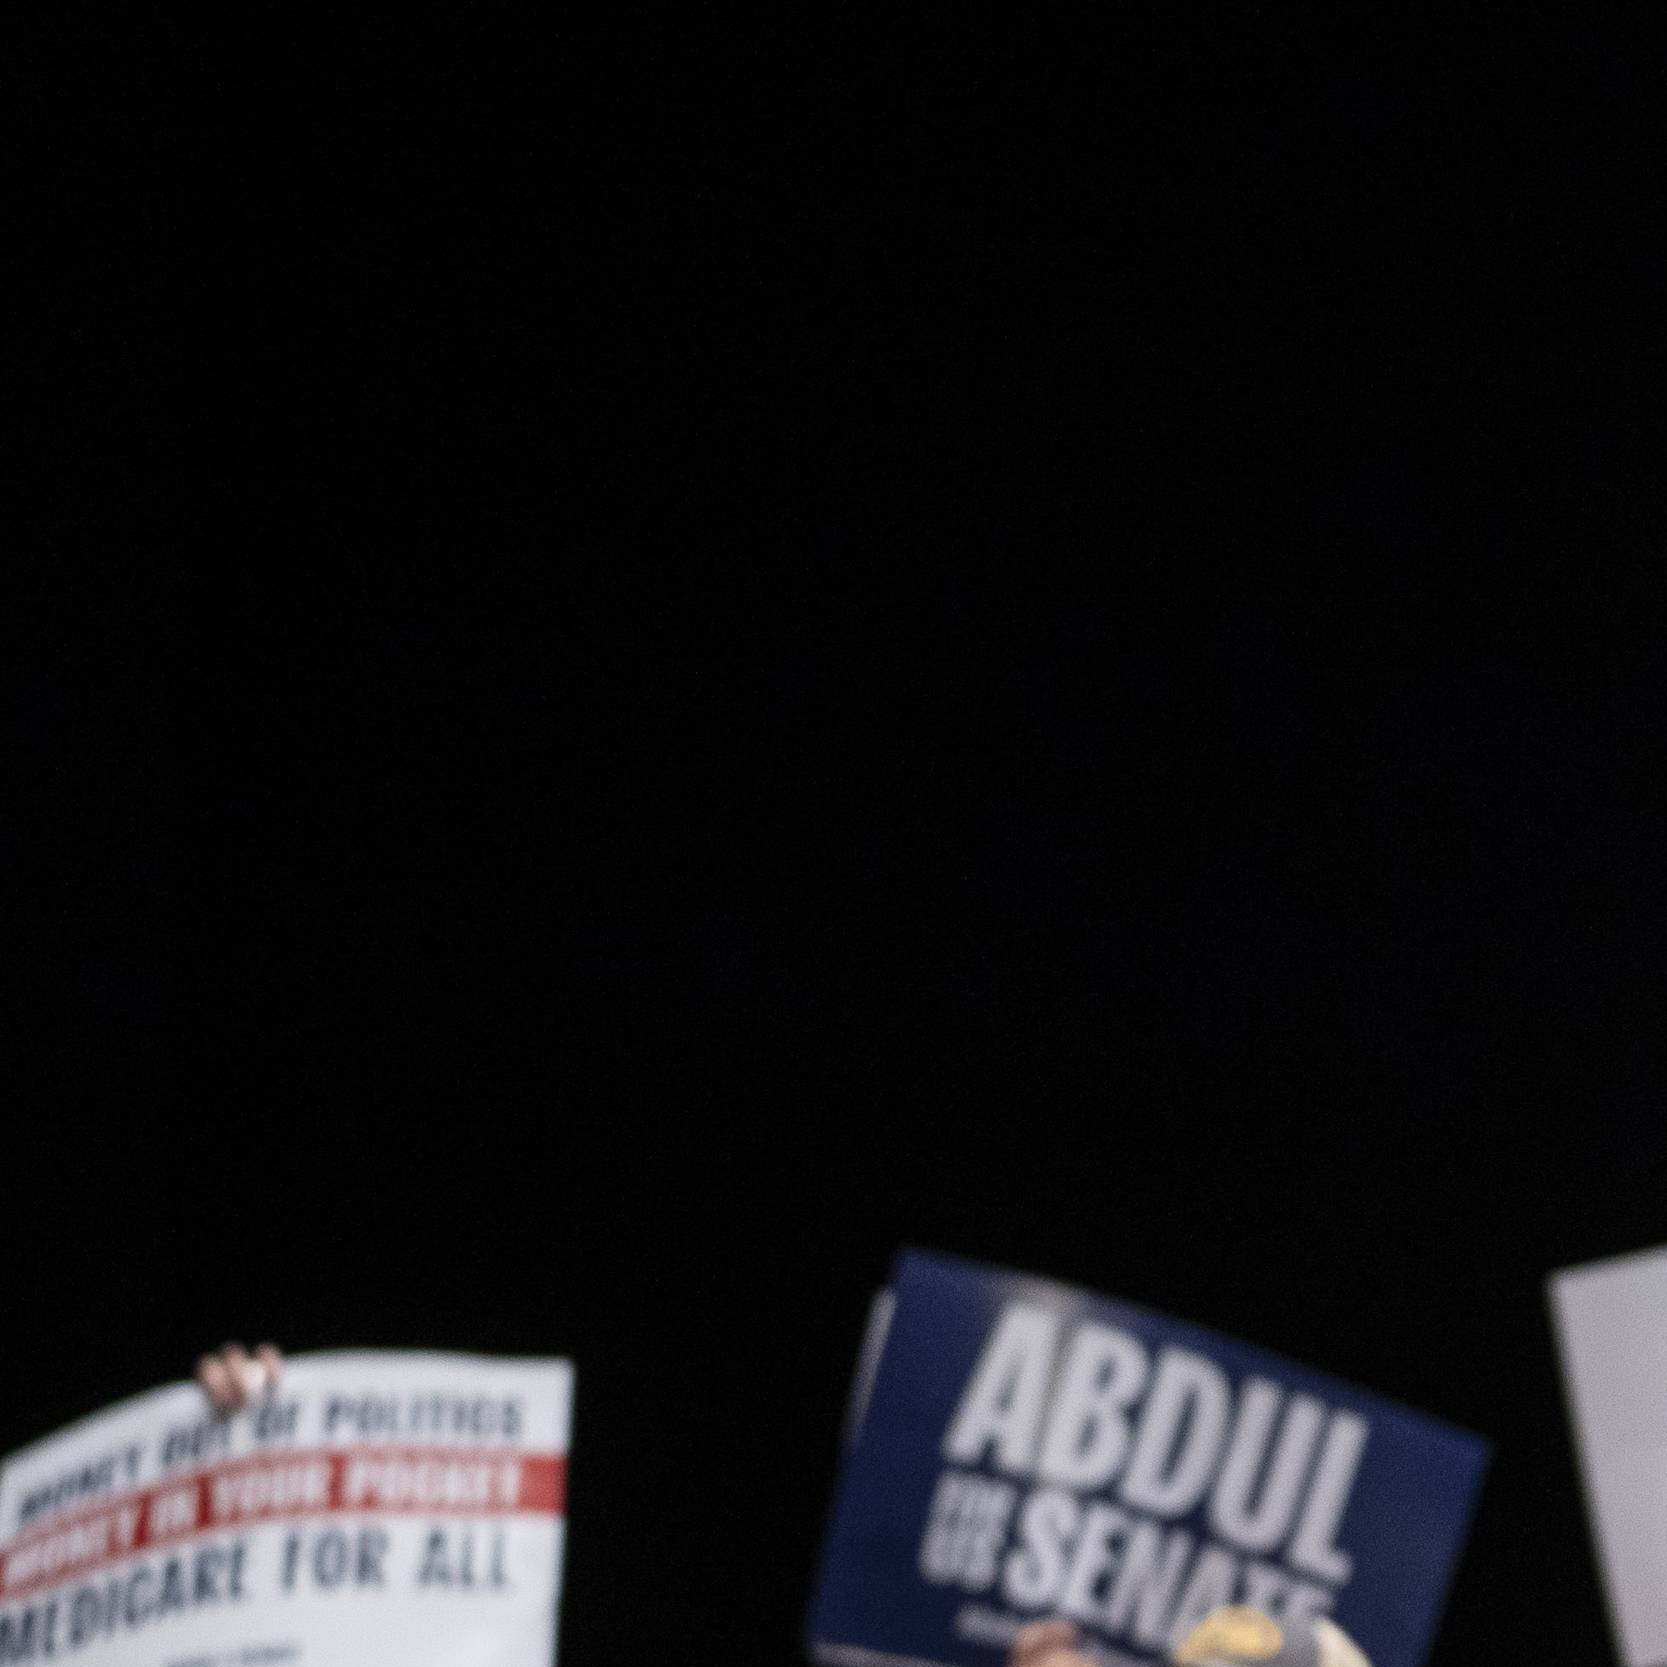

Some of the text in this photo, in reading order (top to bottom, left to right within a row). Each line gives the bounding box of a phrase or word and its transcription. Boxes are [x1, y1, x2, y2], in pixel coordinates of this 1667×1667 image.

[324, 1395, 523, 1440] POLITICS
[940, 1302, 1368, 1587] ABDUL
[280, 1527, 388, 1594] FOR
[413, 1524, 514, 1594] ALL
